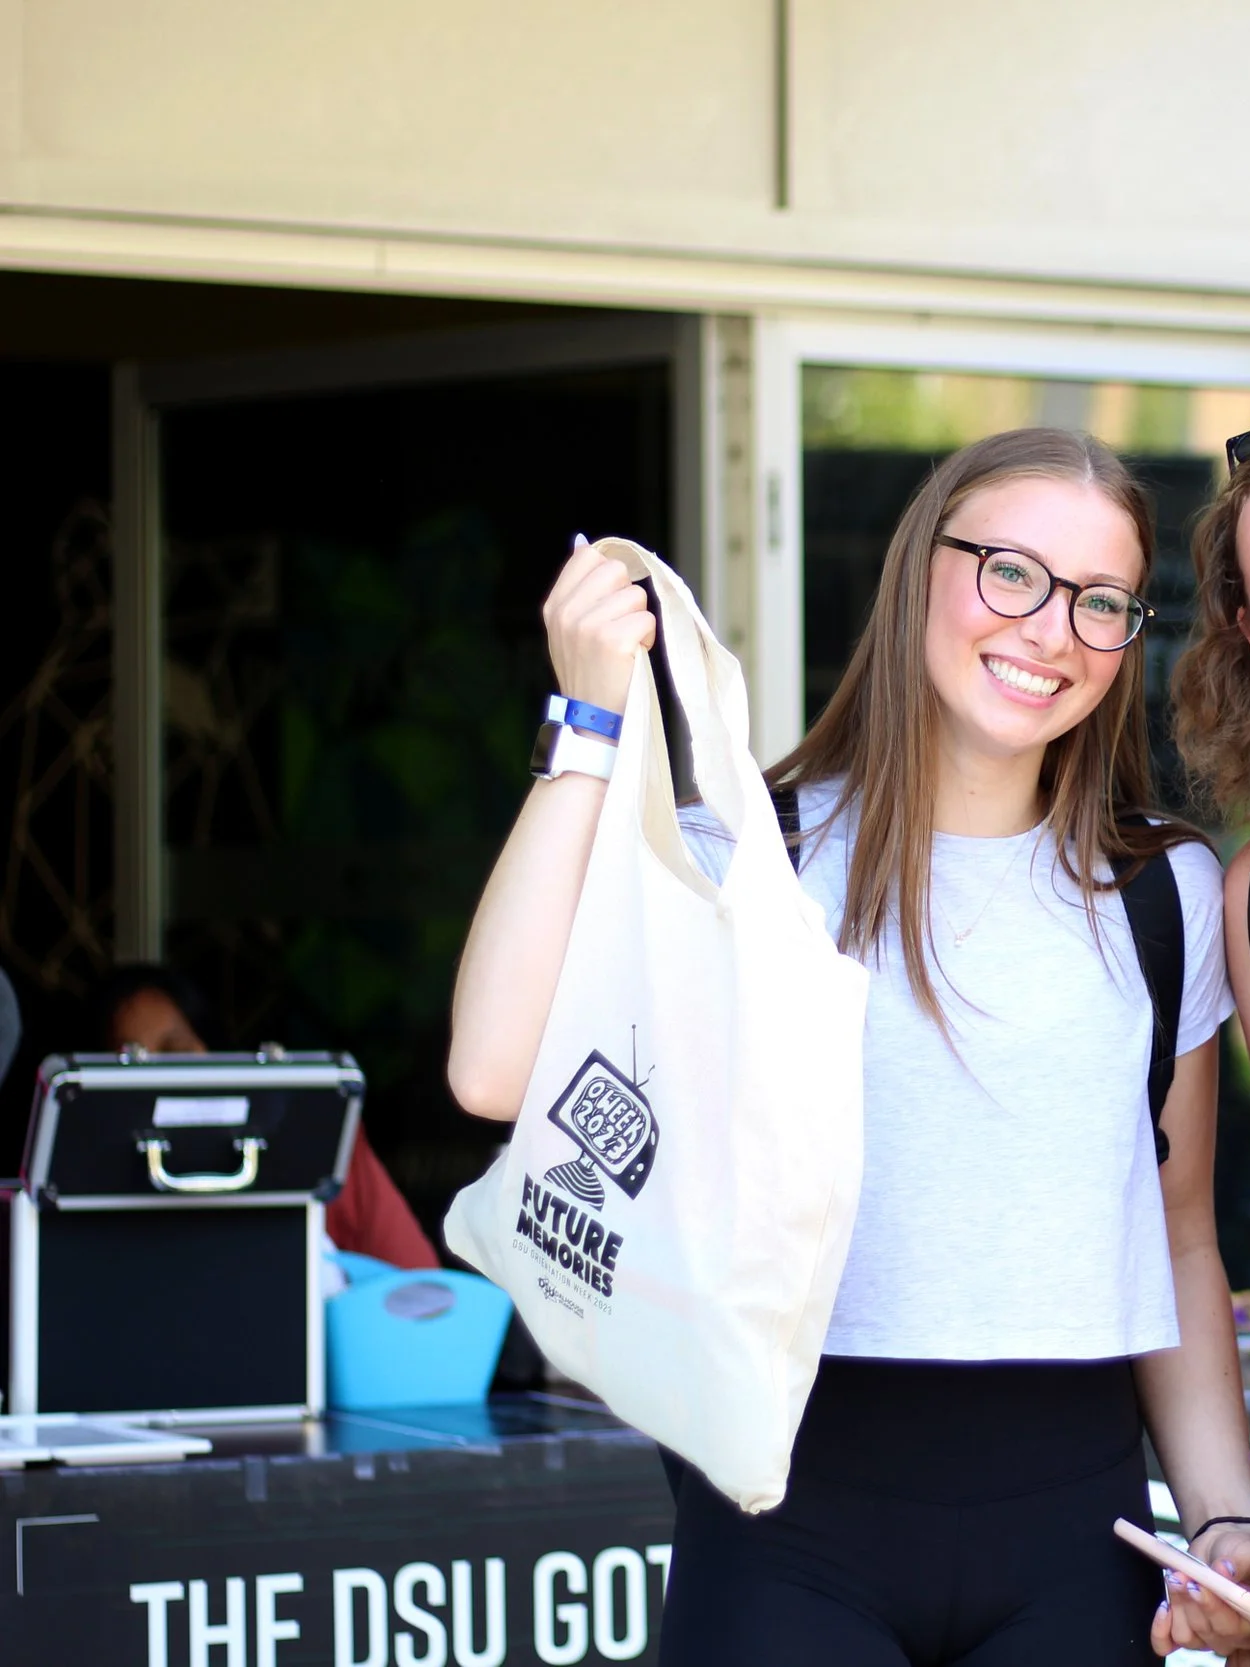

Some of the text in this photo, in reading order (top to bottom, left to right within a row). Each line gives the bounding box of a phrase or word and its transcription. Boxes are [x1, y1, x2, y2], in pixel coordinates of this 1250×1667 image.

[576, 1100, 628, 1160] 2023
[515, 1208, 614, 1298] MEMORIES
[522, 1172, 624, 1272] FUTURE
[512, 1238, 529, 1254] DSU
[530, 1248, 571, 1288] ORIENTATION
[573, 1282, 593, 1303] WEEK
[333, 1557, 506, 1667] DSU
